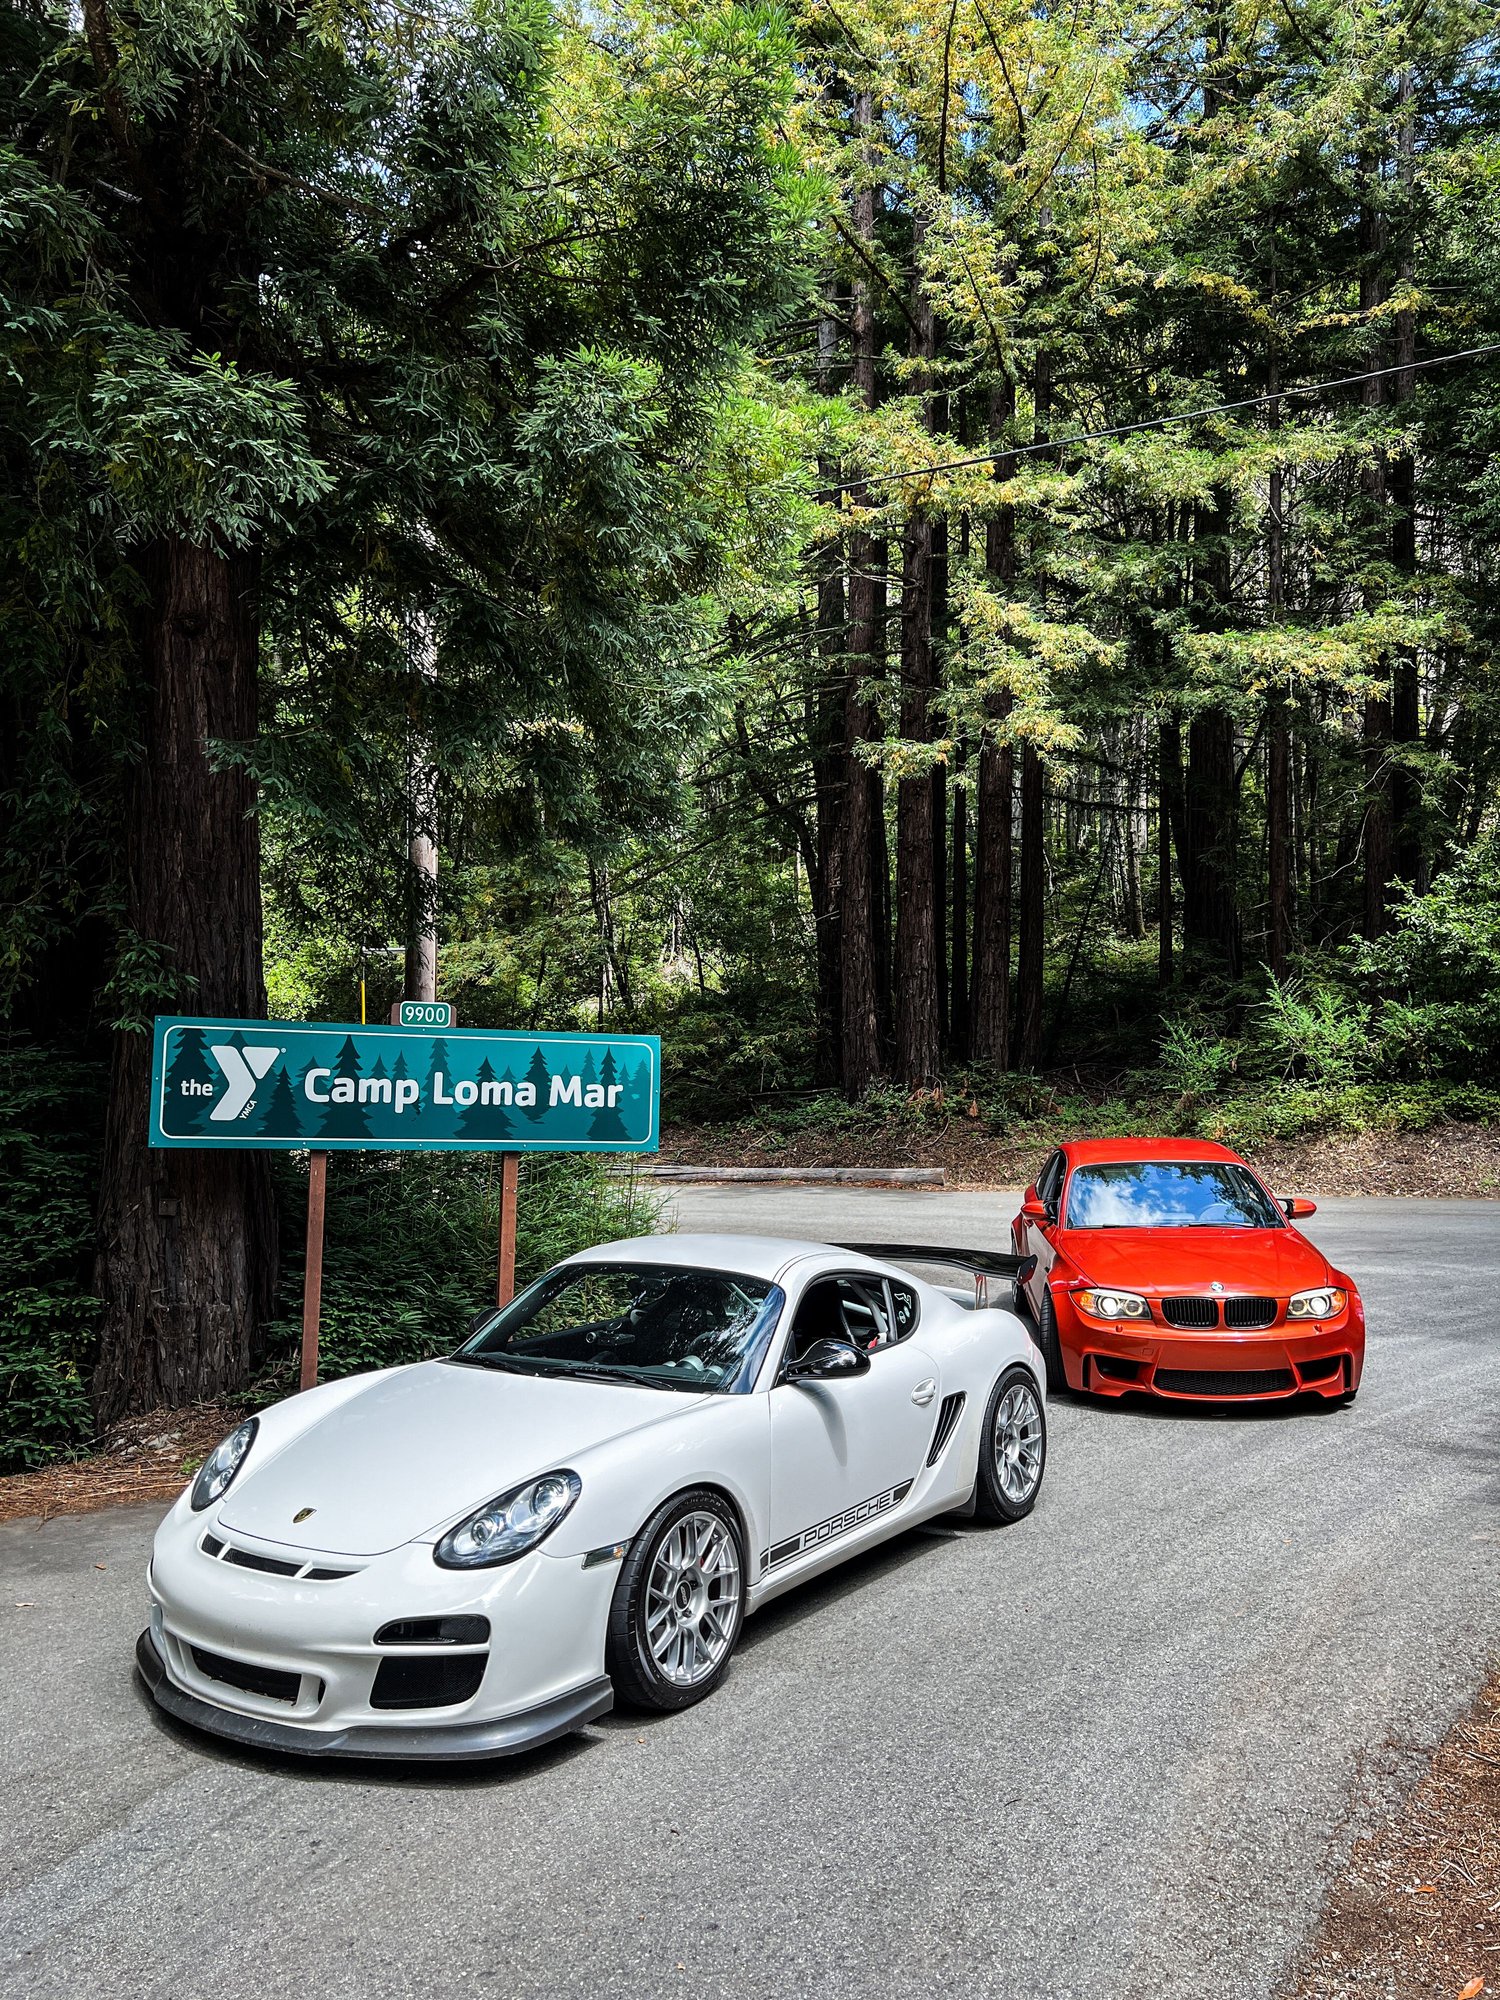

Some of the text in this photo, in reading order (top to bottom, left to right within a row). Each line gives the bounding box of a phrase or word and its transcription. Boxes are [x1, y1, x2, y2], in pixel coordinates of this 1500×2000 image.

[405, 1006, 446, 1023] 9900
[180, 1078, 213, 1096] the
[304, 1068, 624, 1114] Camp Loma Mar
[239, 1099, 258, 1120] YMCA
[803, 1492, 891, 1548] PORSCHE
